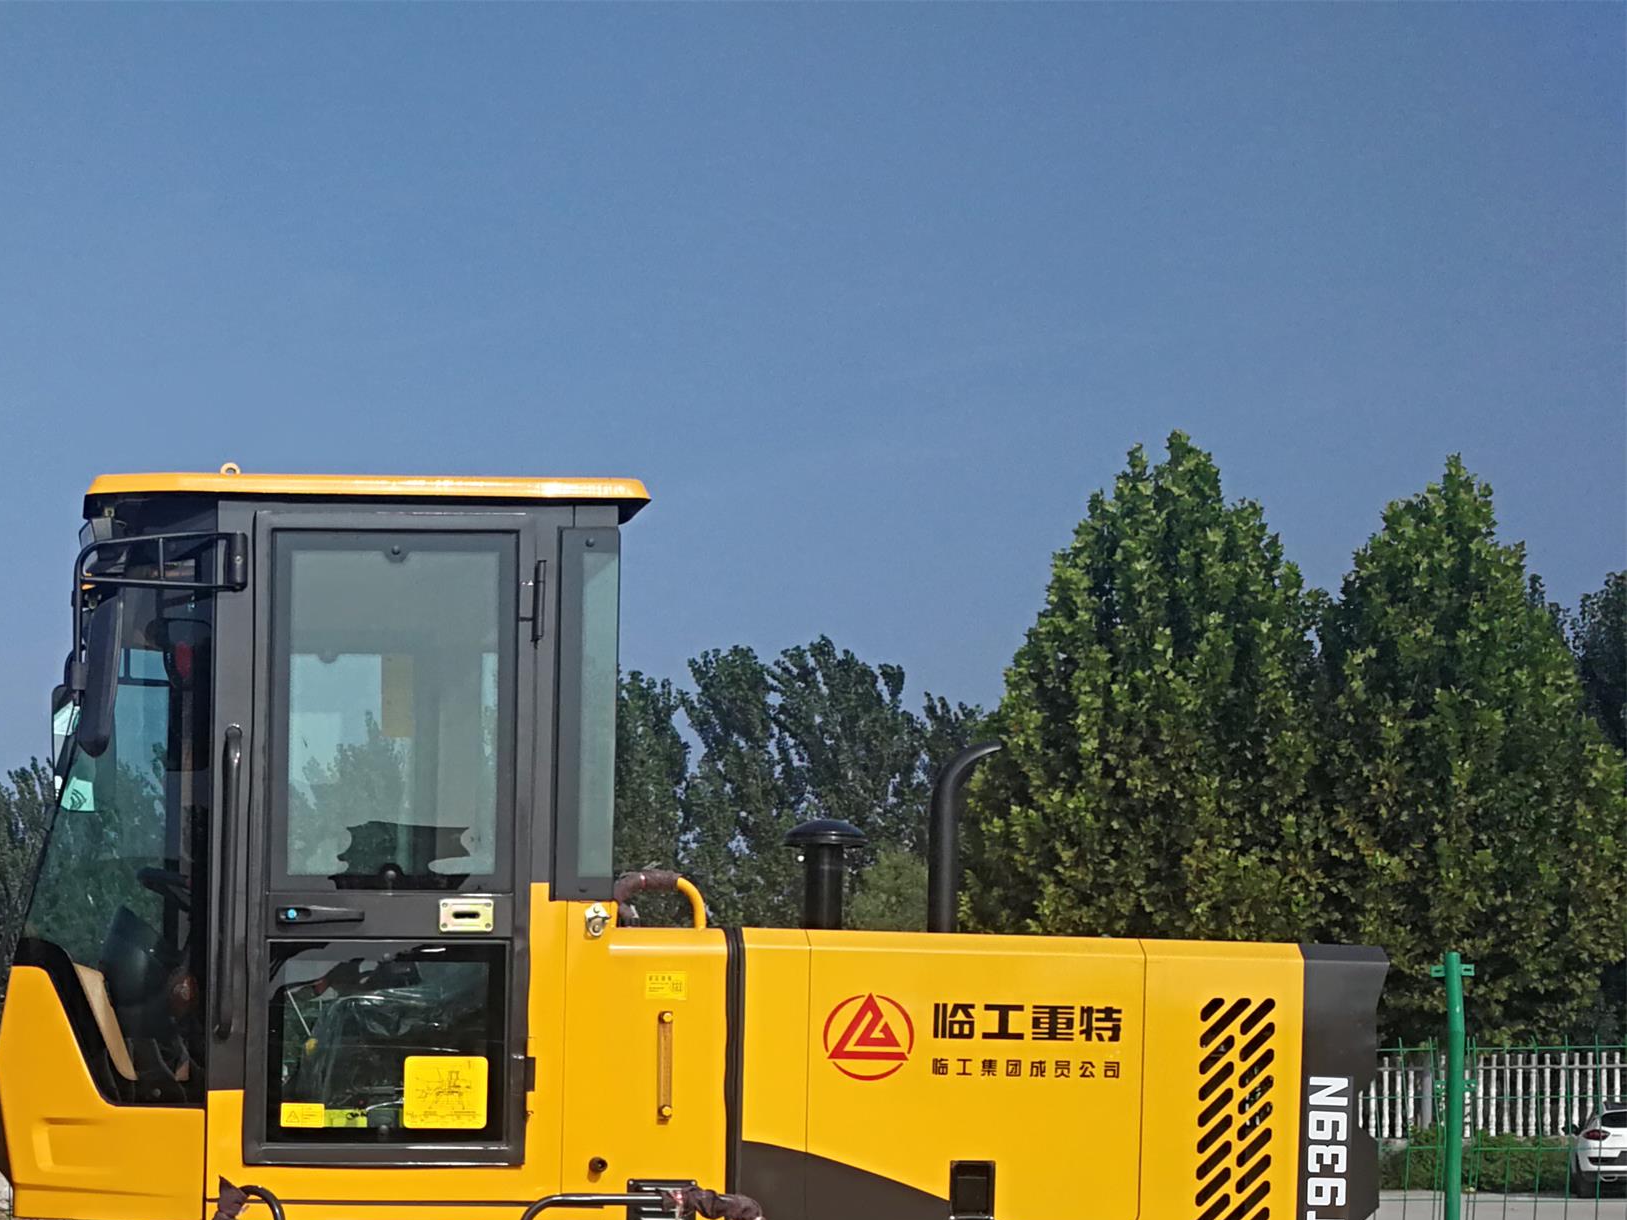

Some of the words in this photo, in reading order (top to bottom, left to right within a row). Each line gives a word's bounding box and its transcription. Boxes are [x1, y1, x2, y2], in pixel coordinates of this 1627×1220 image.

[933, 1002, 1122, 1042] 临工重特
[932, 1057, 1120, 1079] 临工集团成员公司
